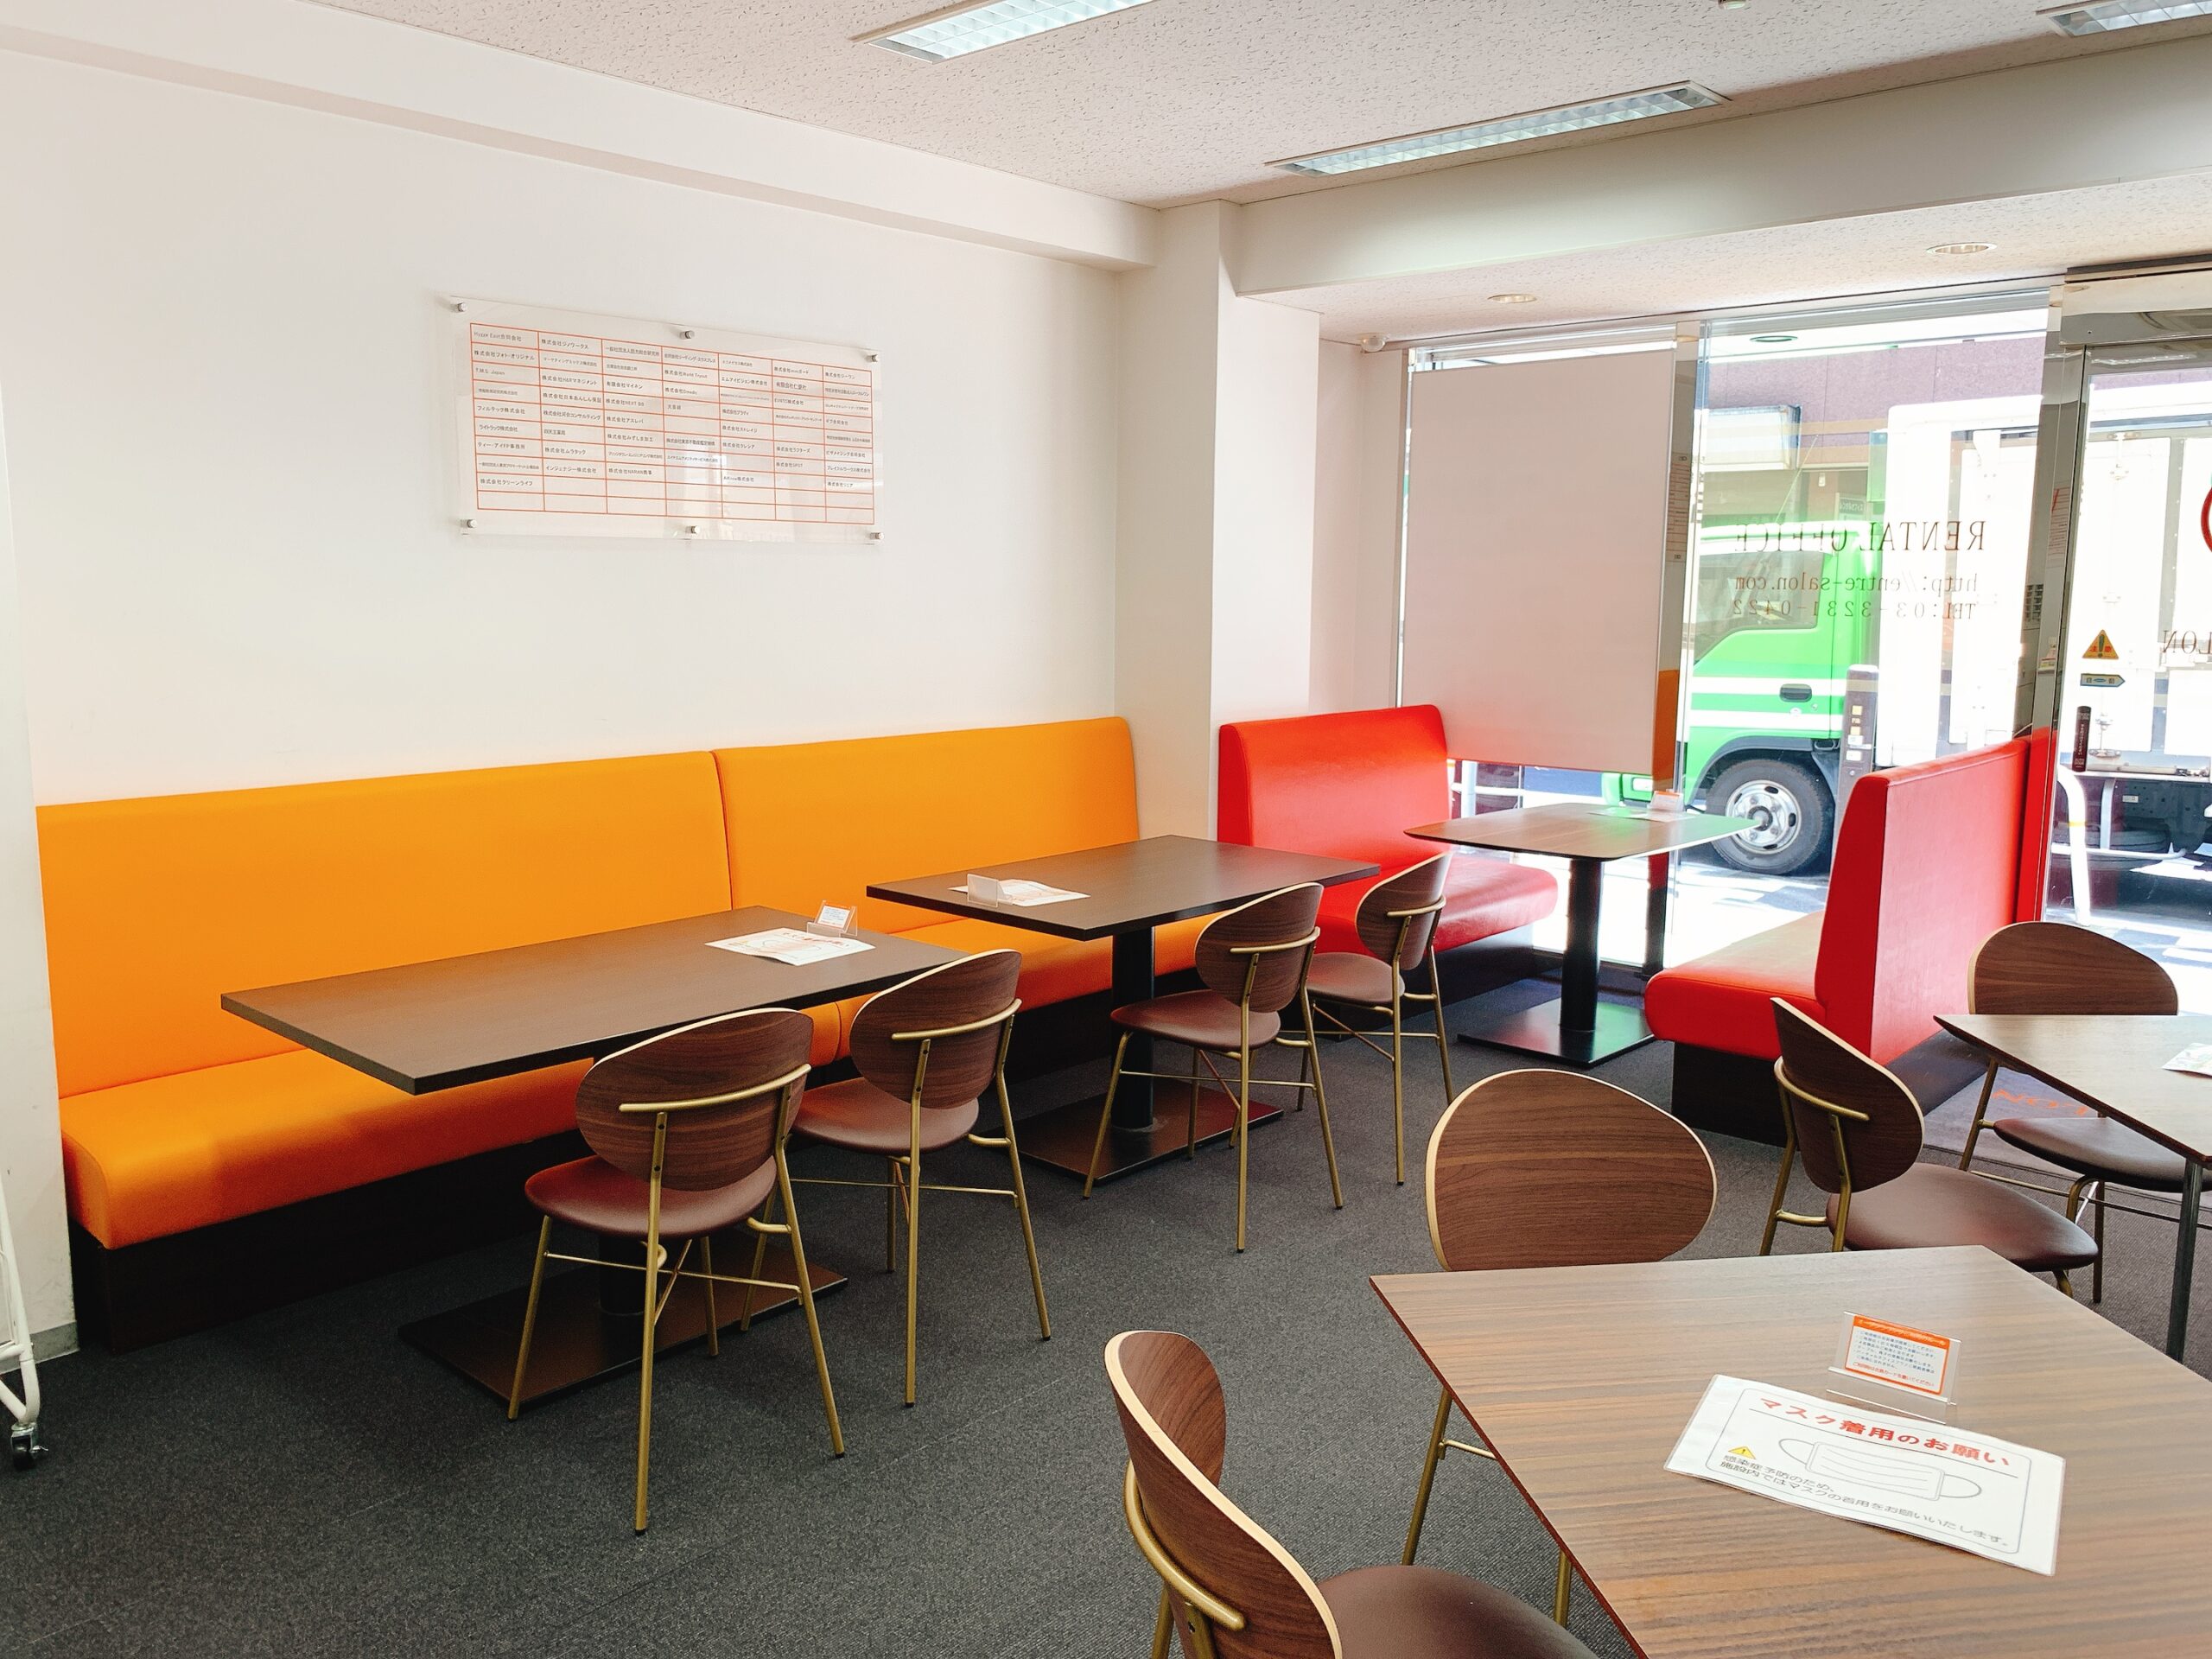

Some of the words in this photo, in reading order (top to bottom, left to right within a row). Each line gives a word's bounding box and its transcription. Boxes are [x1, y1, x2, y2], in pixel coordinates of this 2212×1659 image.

[1759, 1398, 2009, 1466] マスク着用のお願い
[1719, 1462, 2009, 1547] 施設内ではマスクの着用をお願いいたします。
[1724, 1454, 1835, 1493] 感染症予防のため、
